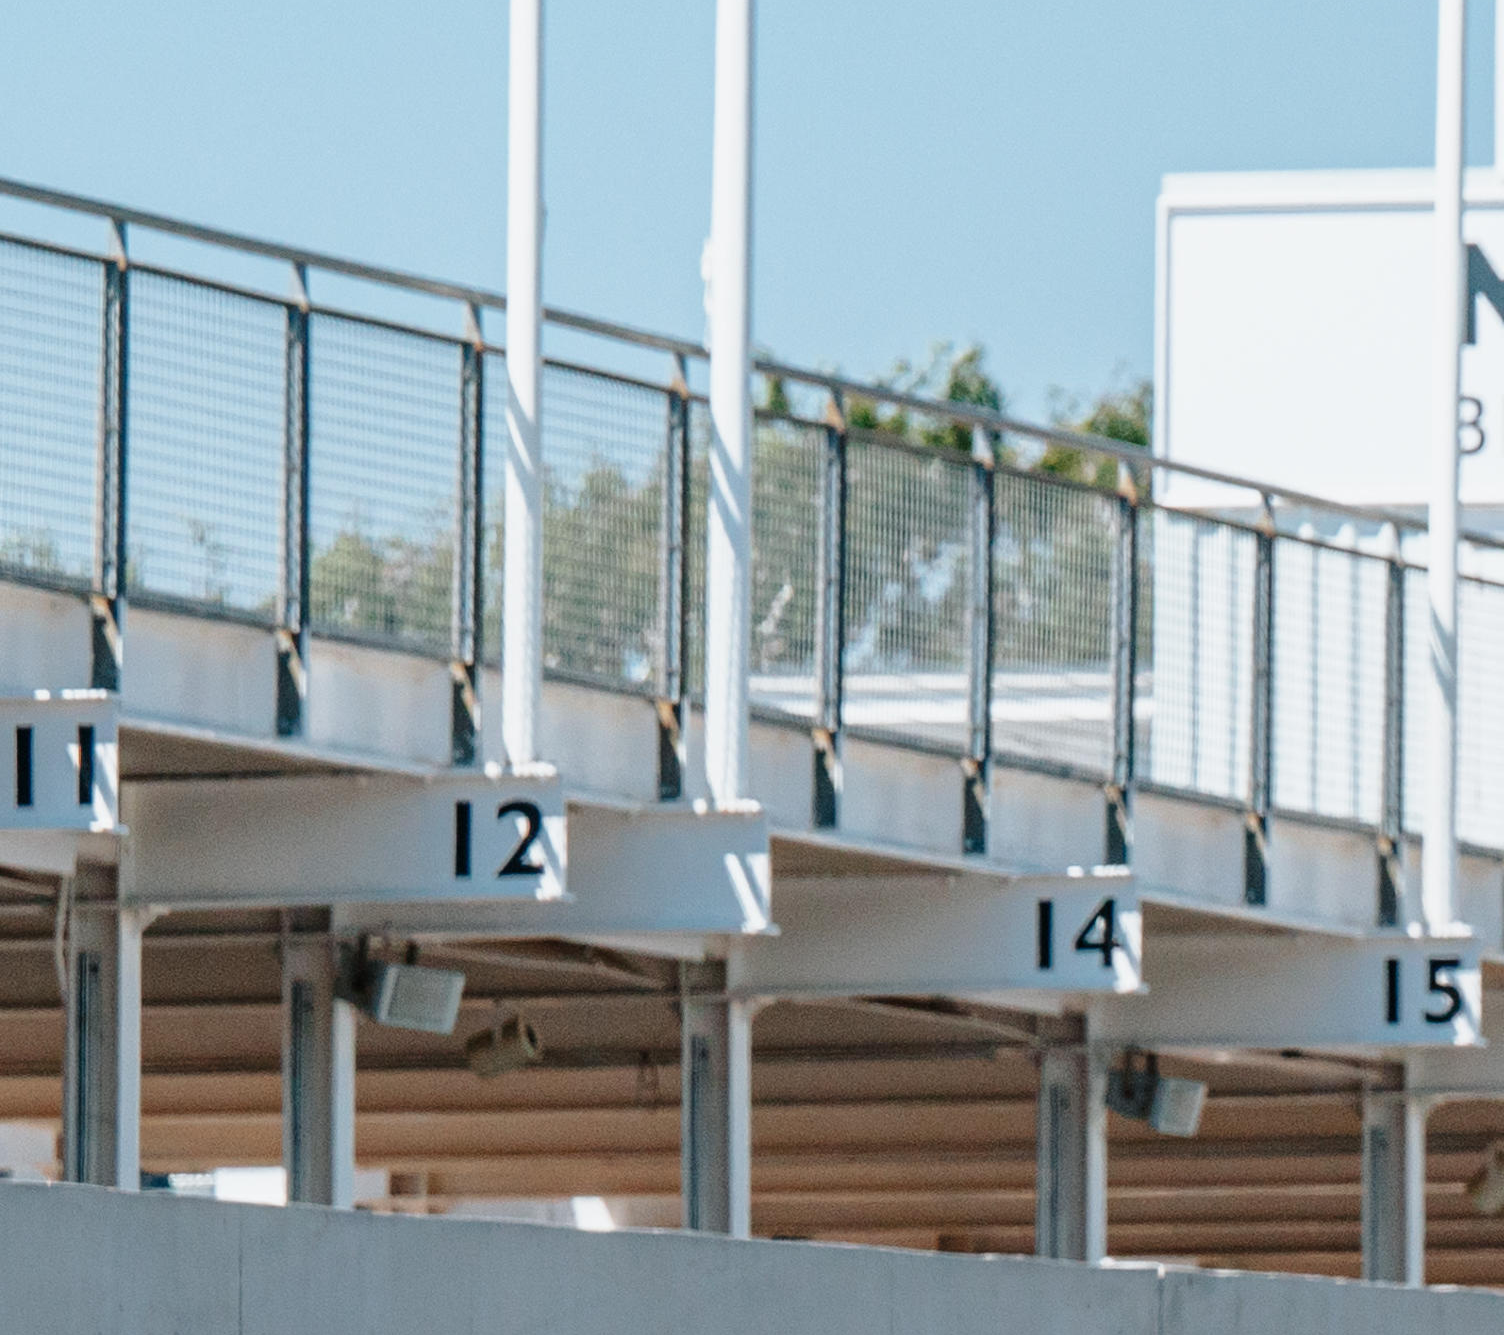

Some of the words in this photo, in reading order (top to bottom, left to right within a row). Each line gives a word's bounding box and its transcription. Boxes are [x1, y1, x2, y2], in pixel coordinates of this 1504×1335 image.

[14, 724, 96, 808] 11
[454, 799, 545, 879] 12
[1037, 897, 1119, 971] 14
[1384, 957, 1461, 1026] 15
